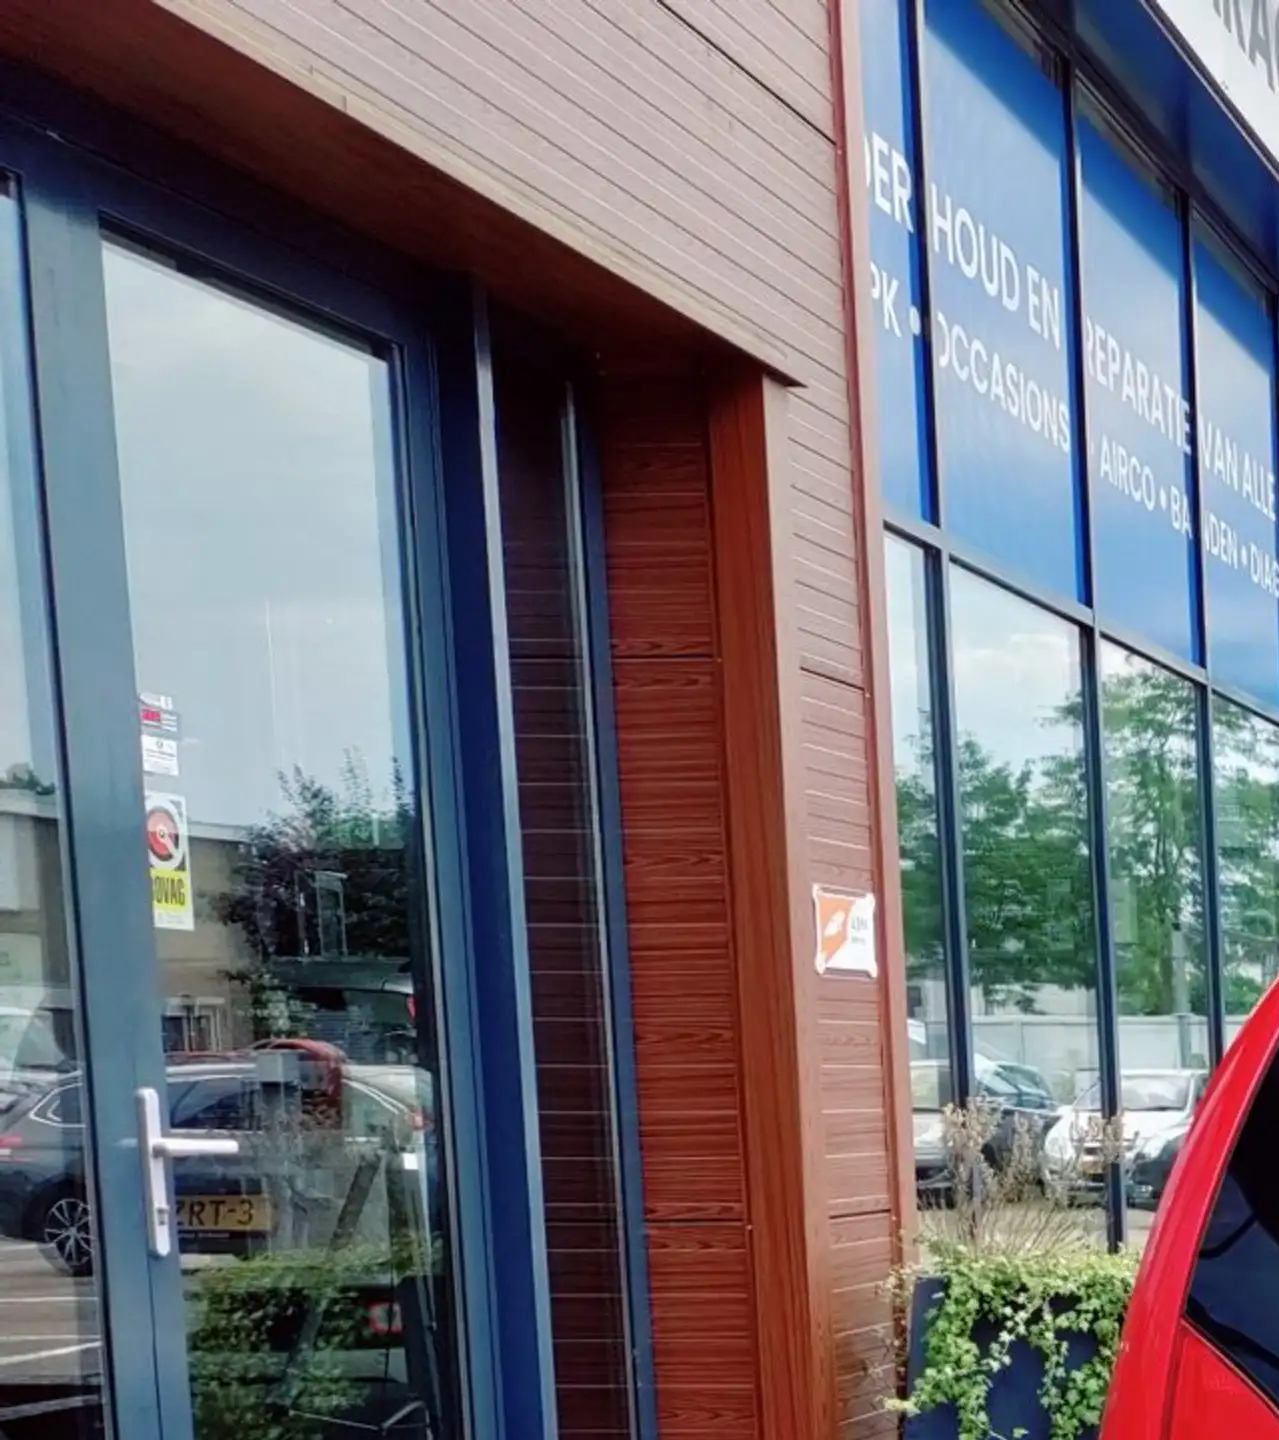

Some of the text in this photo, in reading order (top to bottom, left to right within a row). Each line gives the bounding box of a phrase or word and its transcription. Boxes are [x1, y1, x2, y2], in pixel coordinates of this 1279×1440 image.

[1026, 264, 1060, 351] EN
[1242, 453, 1276, 522] ALLE
[1100, 433, 1155, 511] AIRCO
